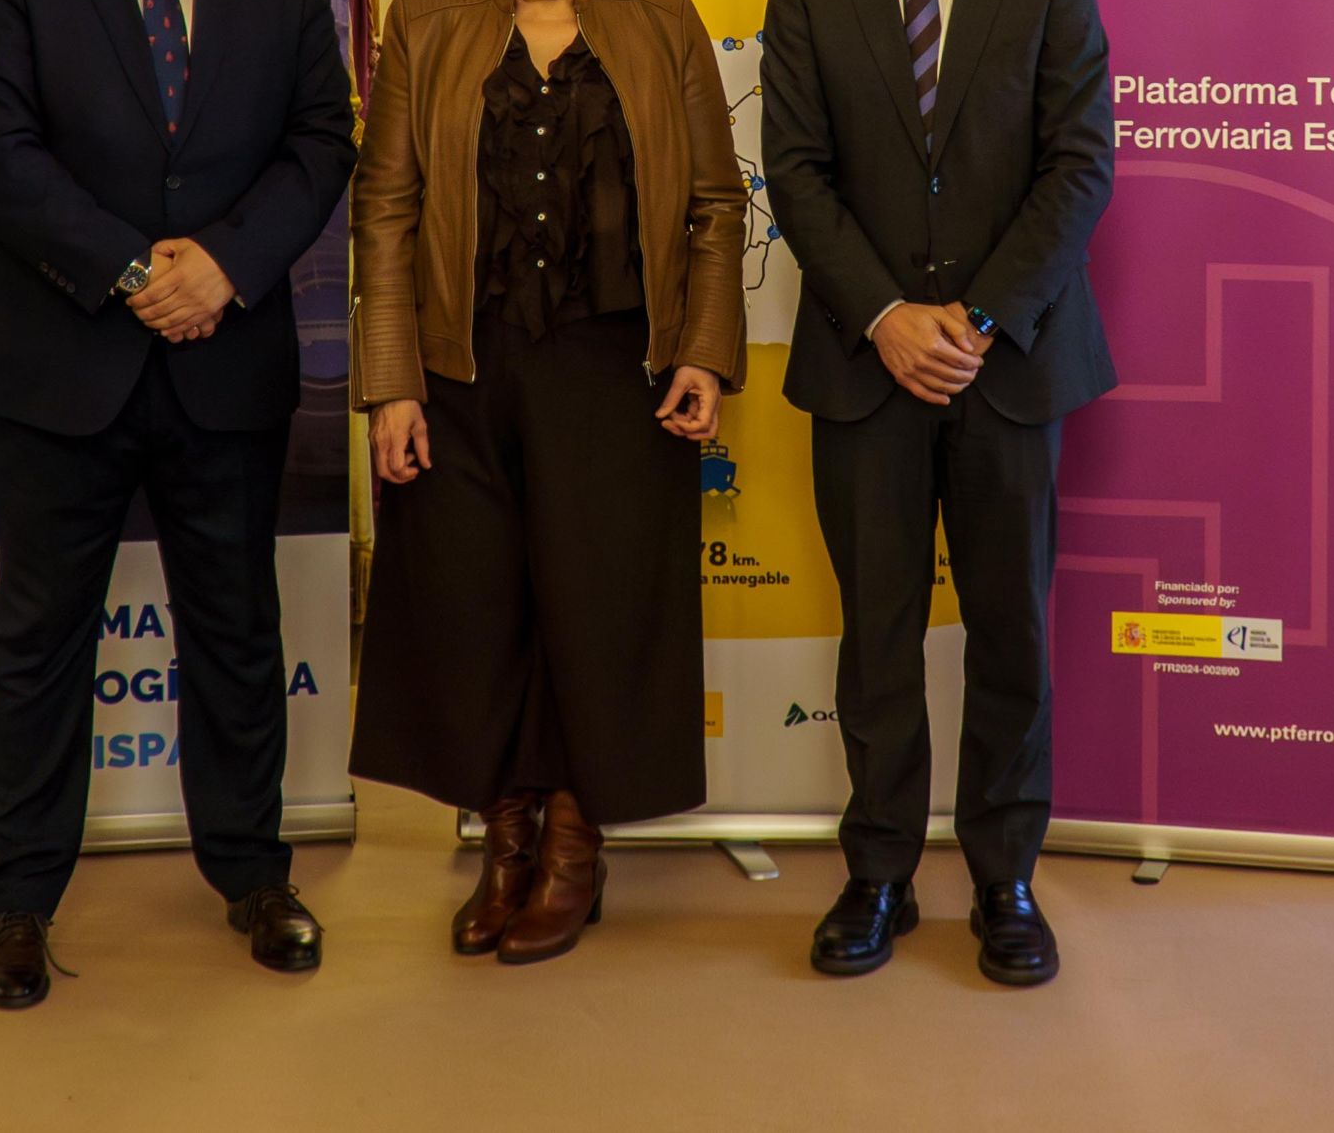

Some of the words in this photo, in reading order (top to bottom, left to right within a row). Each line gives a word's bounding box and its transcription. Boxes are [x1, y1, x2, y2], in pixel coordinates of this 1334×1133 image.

[1113, 75, 1298, 105] Plataforma
[1113, 120, 1293, 150] Ferroviaria
[712, 571, 790, 588] navegable
[1155, 581, 1215, 593] Financiado
[1217, 584, 1240, 595] por:
[1158, 594, 1217, 606] Sponsored
